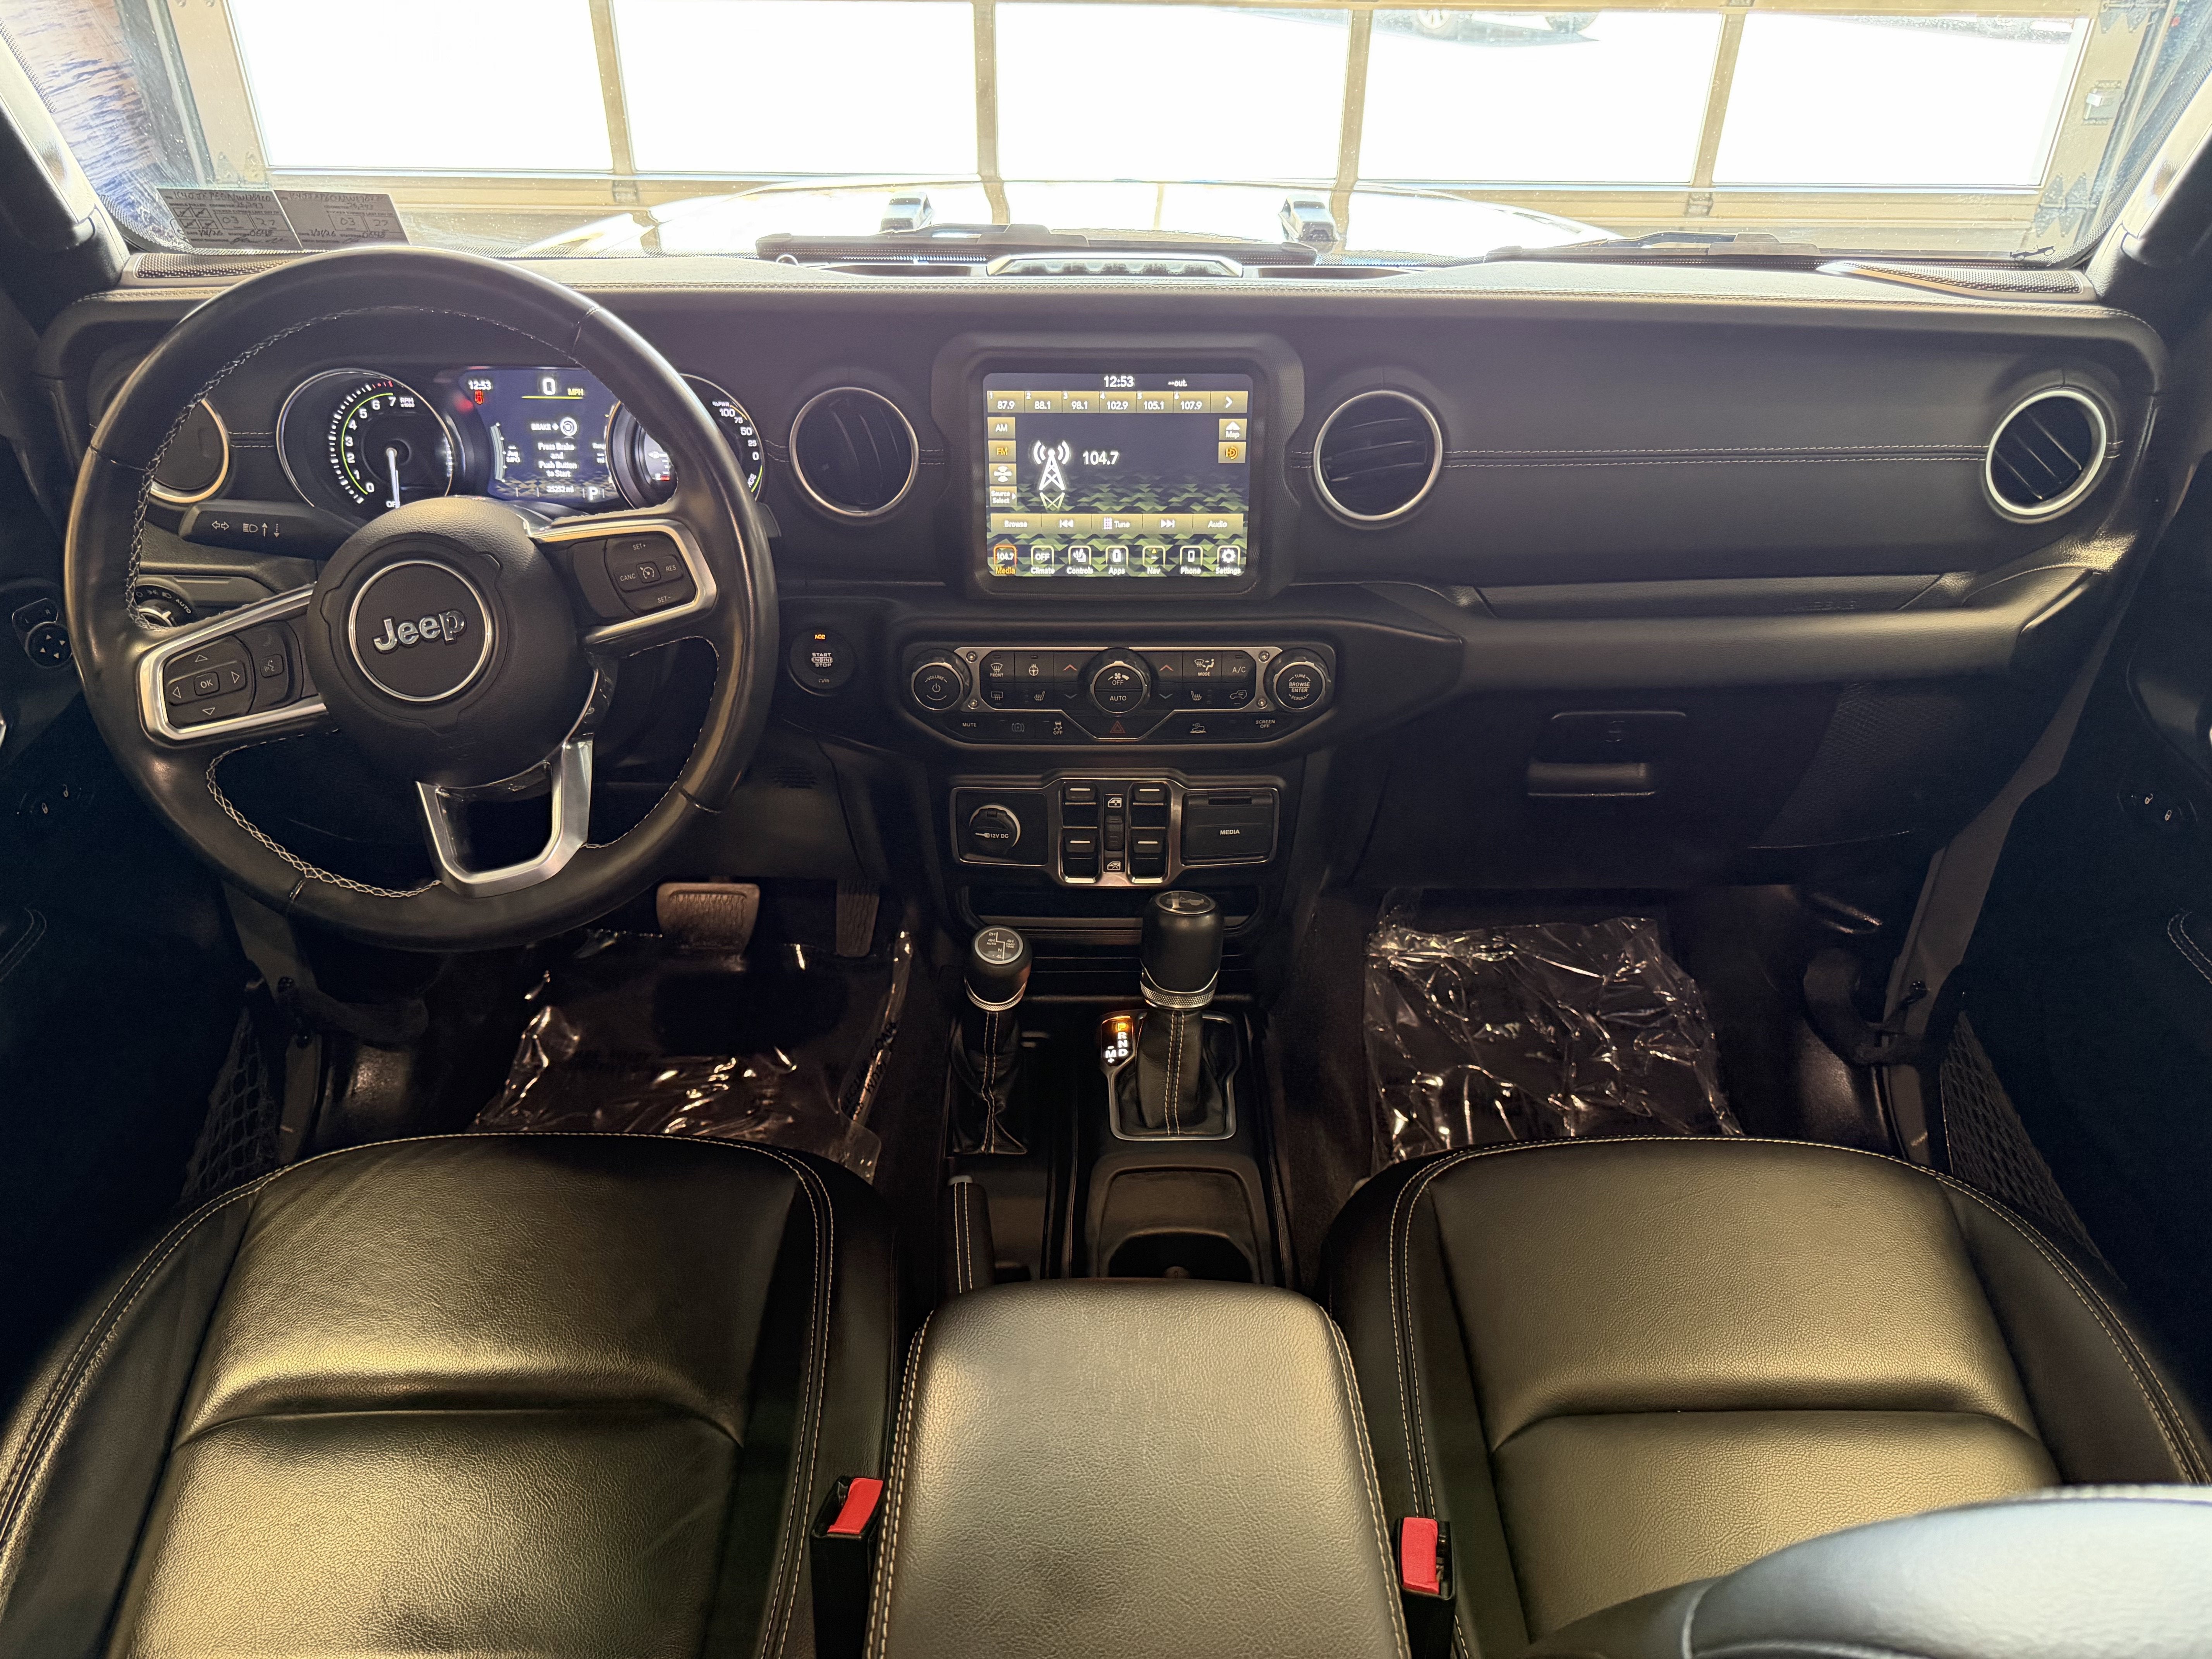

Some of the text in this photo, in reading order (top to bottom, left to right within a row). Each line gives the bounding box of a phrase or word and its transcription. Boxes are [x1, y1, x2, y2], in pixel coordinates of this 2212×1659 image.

[340, 217, 355, 225] 03
[468, 380, 492, 390] 12:53
[542, 377, 556, 395] 0
[1104, 376, 1134, 387] 12:53
[372, 400, 380, 410] 6
[388, 397, 396, 406] 7
[997, 400, 1015, 410] 87.9
[1034, 400, 1051, 410] 88.1
[1071, 400, 1088, 410] 98.1
[1106, 400, 1128, 410] 102.9
[1143, 400, 1164, 410] 105.1
[1180, 400, 1202, 410] 107.9
[359, 409, 367, 418] 5
[720, 409, 735, 417] 100
[349, 420, 357, 430] 4
[995, 424, 1008, 432] AM
[740, 427, 752, 436] 50
[1225, 430, 1240, 439] Map
[345, 437, 353, 447] 3
[538, 442, 575, 451] Press Brake
[996, 447, 1008, 455] FM
[347, 453, 355, 463] 2
[752, 452, 759, 460] 0
[1083, 450, 1119, 465] 104.7
[538, 461, 577, 469] Push Button
[354, 470, 360, 479] 1
[366, 482, 374, 492] 0
[589, 487, 598, 500] P
[1108, 567, 1125, 575] Apps
[1216, 567, 1241, 575] Settings
[175, 599, 191, 614] AUTO
[374, 610, 464, 651] Jeep
[200, 680, 213, 689] OK
[1118, 1023, 1127, 1031] P
[1118, 1040, 1128, 1048] N
[1105, 1049, 1116, 1058] M
